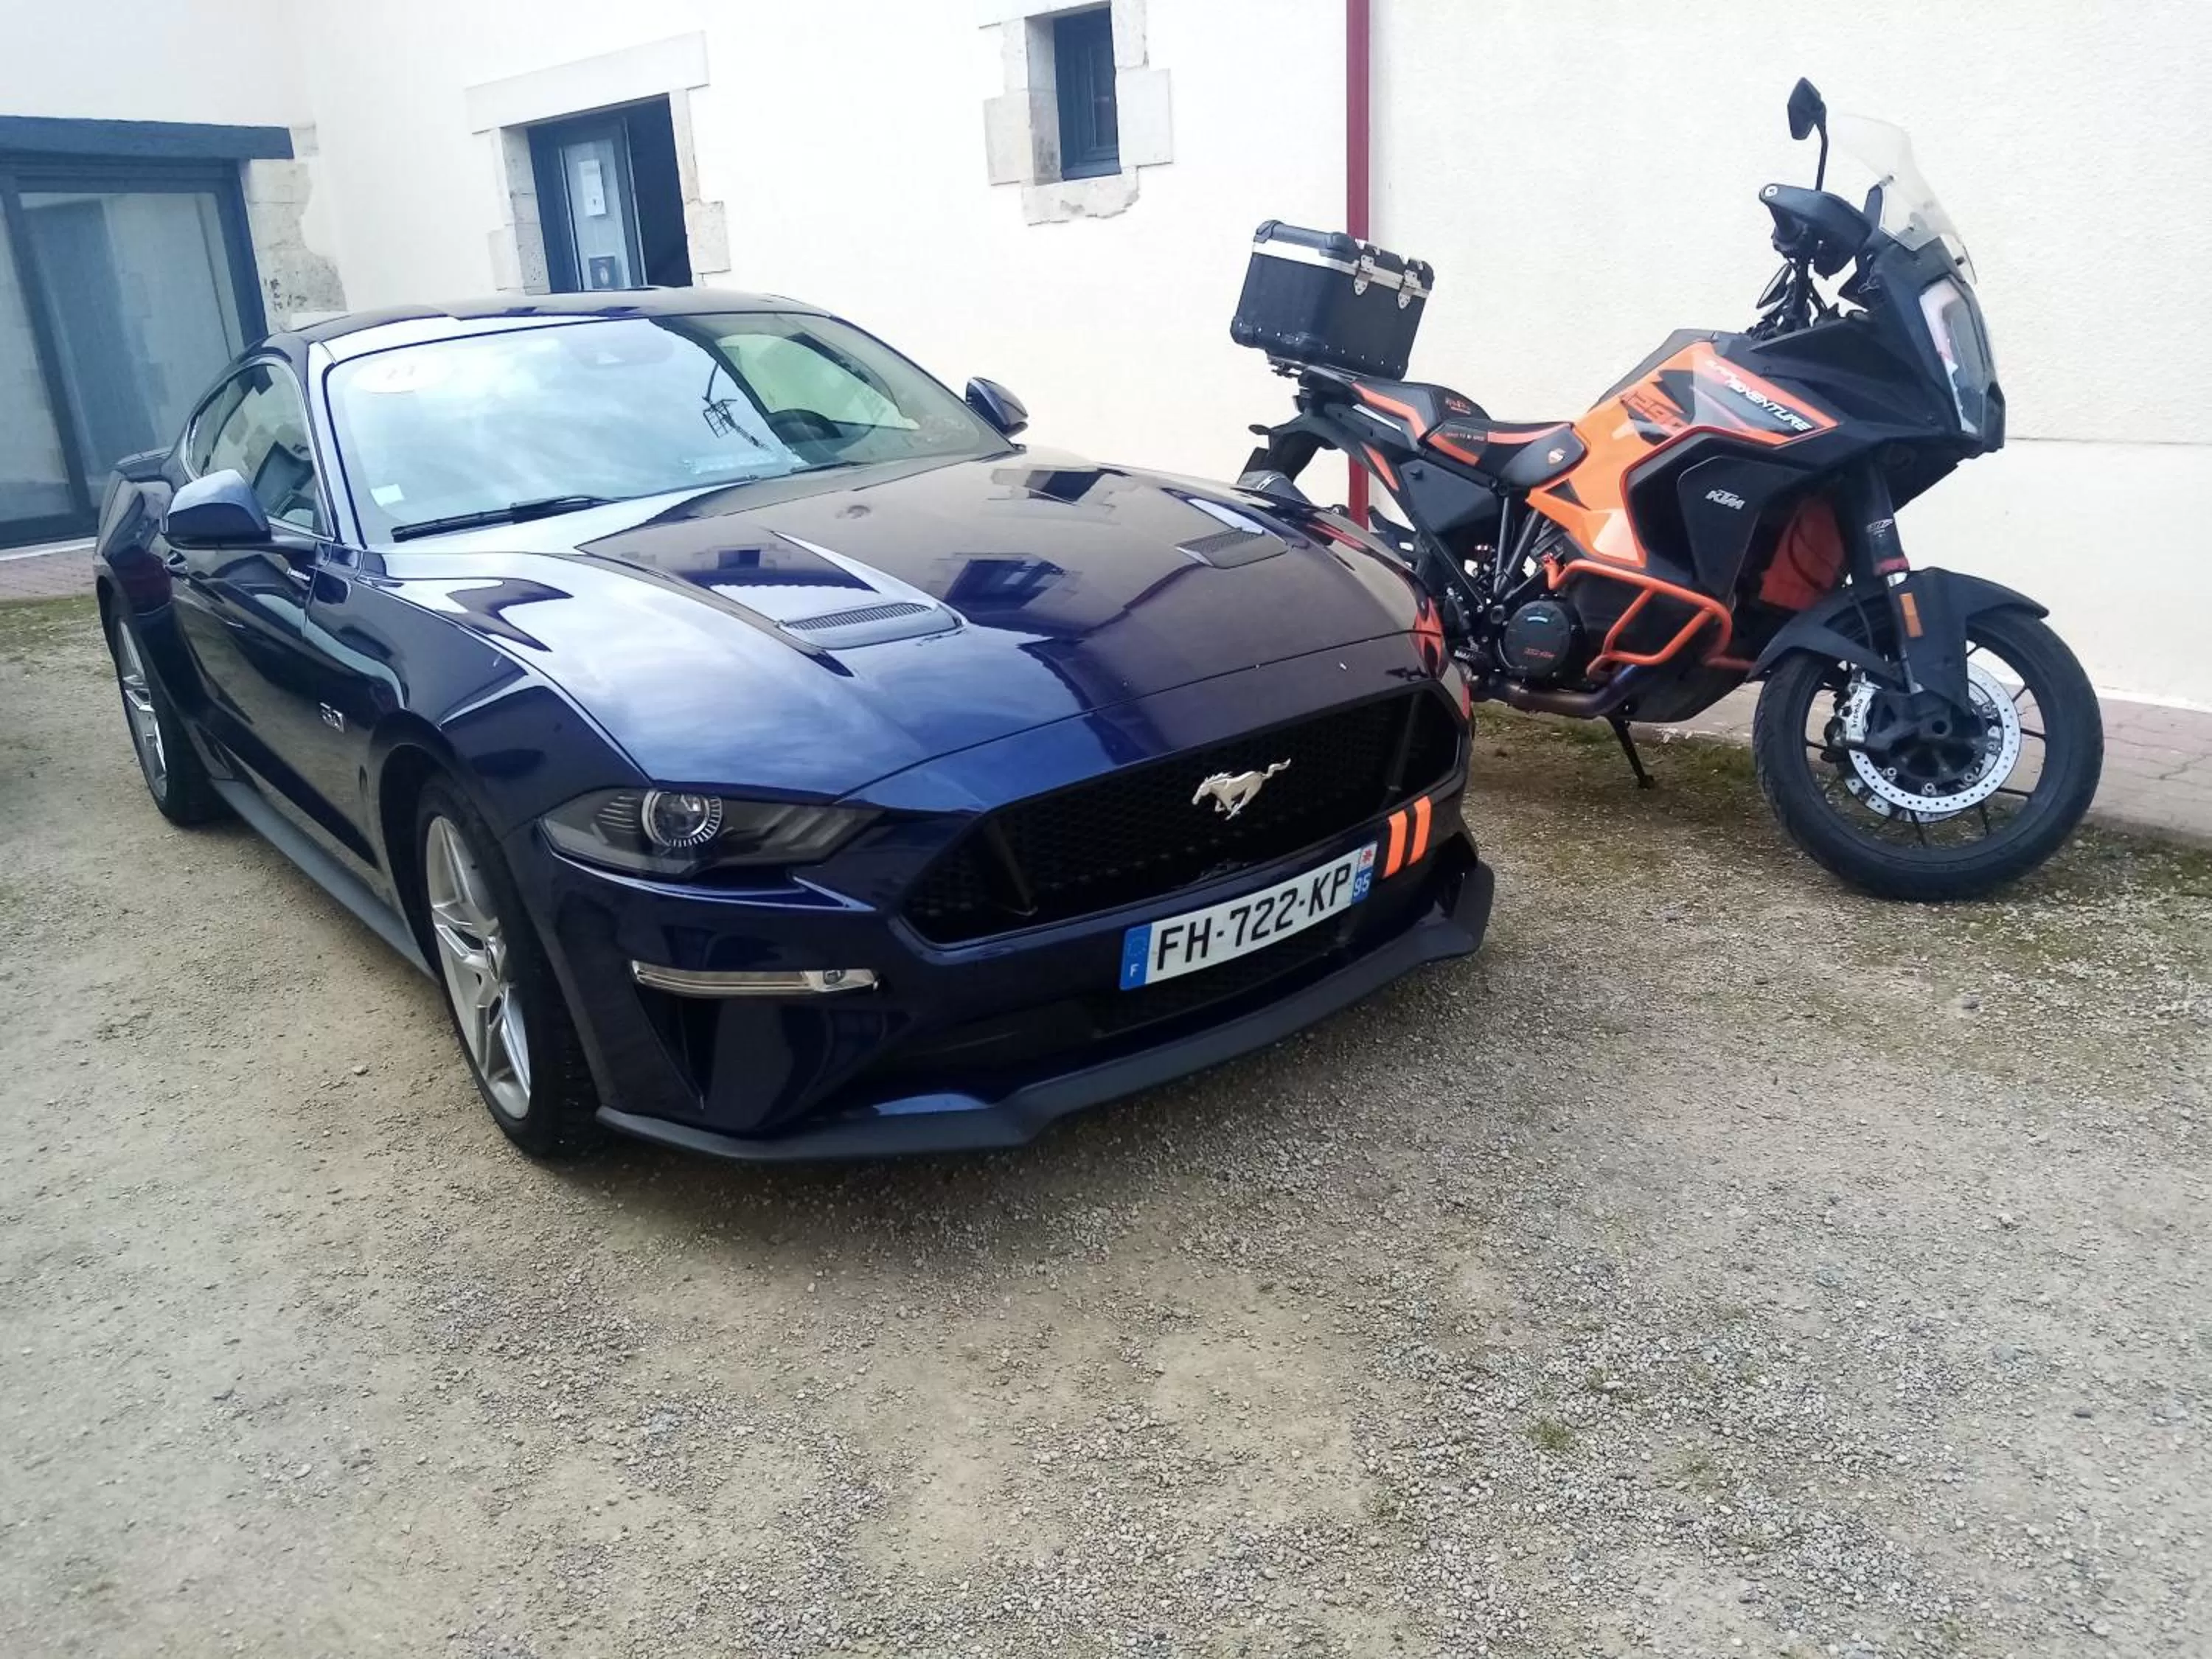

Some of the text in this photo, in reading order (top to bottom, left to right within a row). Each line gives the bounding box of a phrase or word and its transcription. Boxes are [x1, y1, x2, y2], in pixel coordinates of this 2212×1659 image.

[1725, 376, 1814, 432] ADVENTURE
[1705, 490, 1745, 509] KTM
[1354, 872, 1371, 897] 95
[1156, 863, 1352, 971] FH-722-KP
[1129, 964, 1139, 977] F
